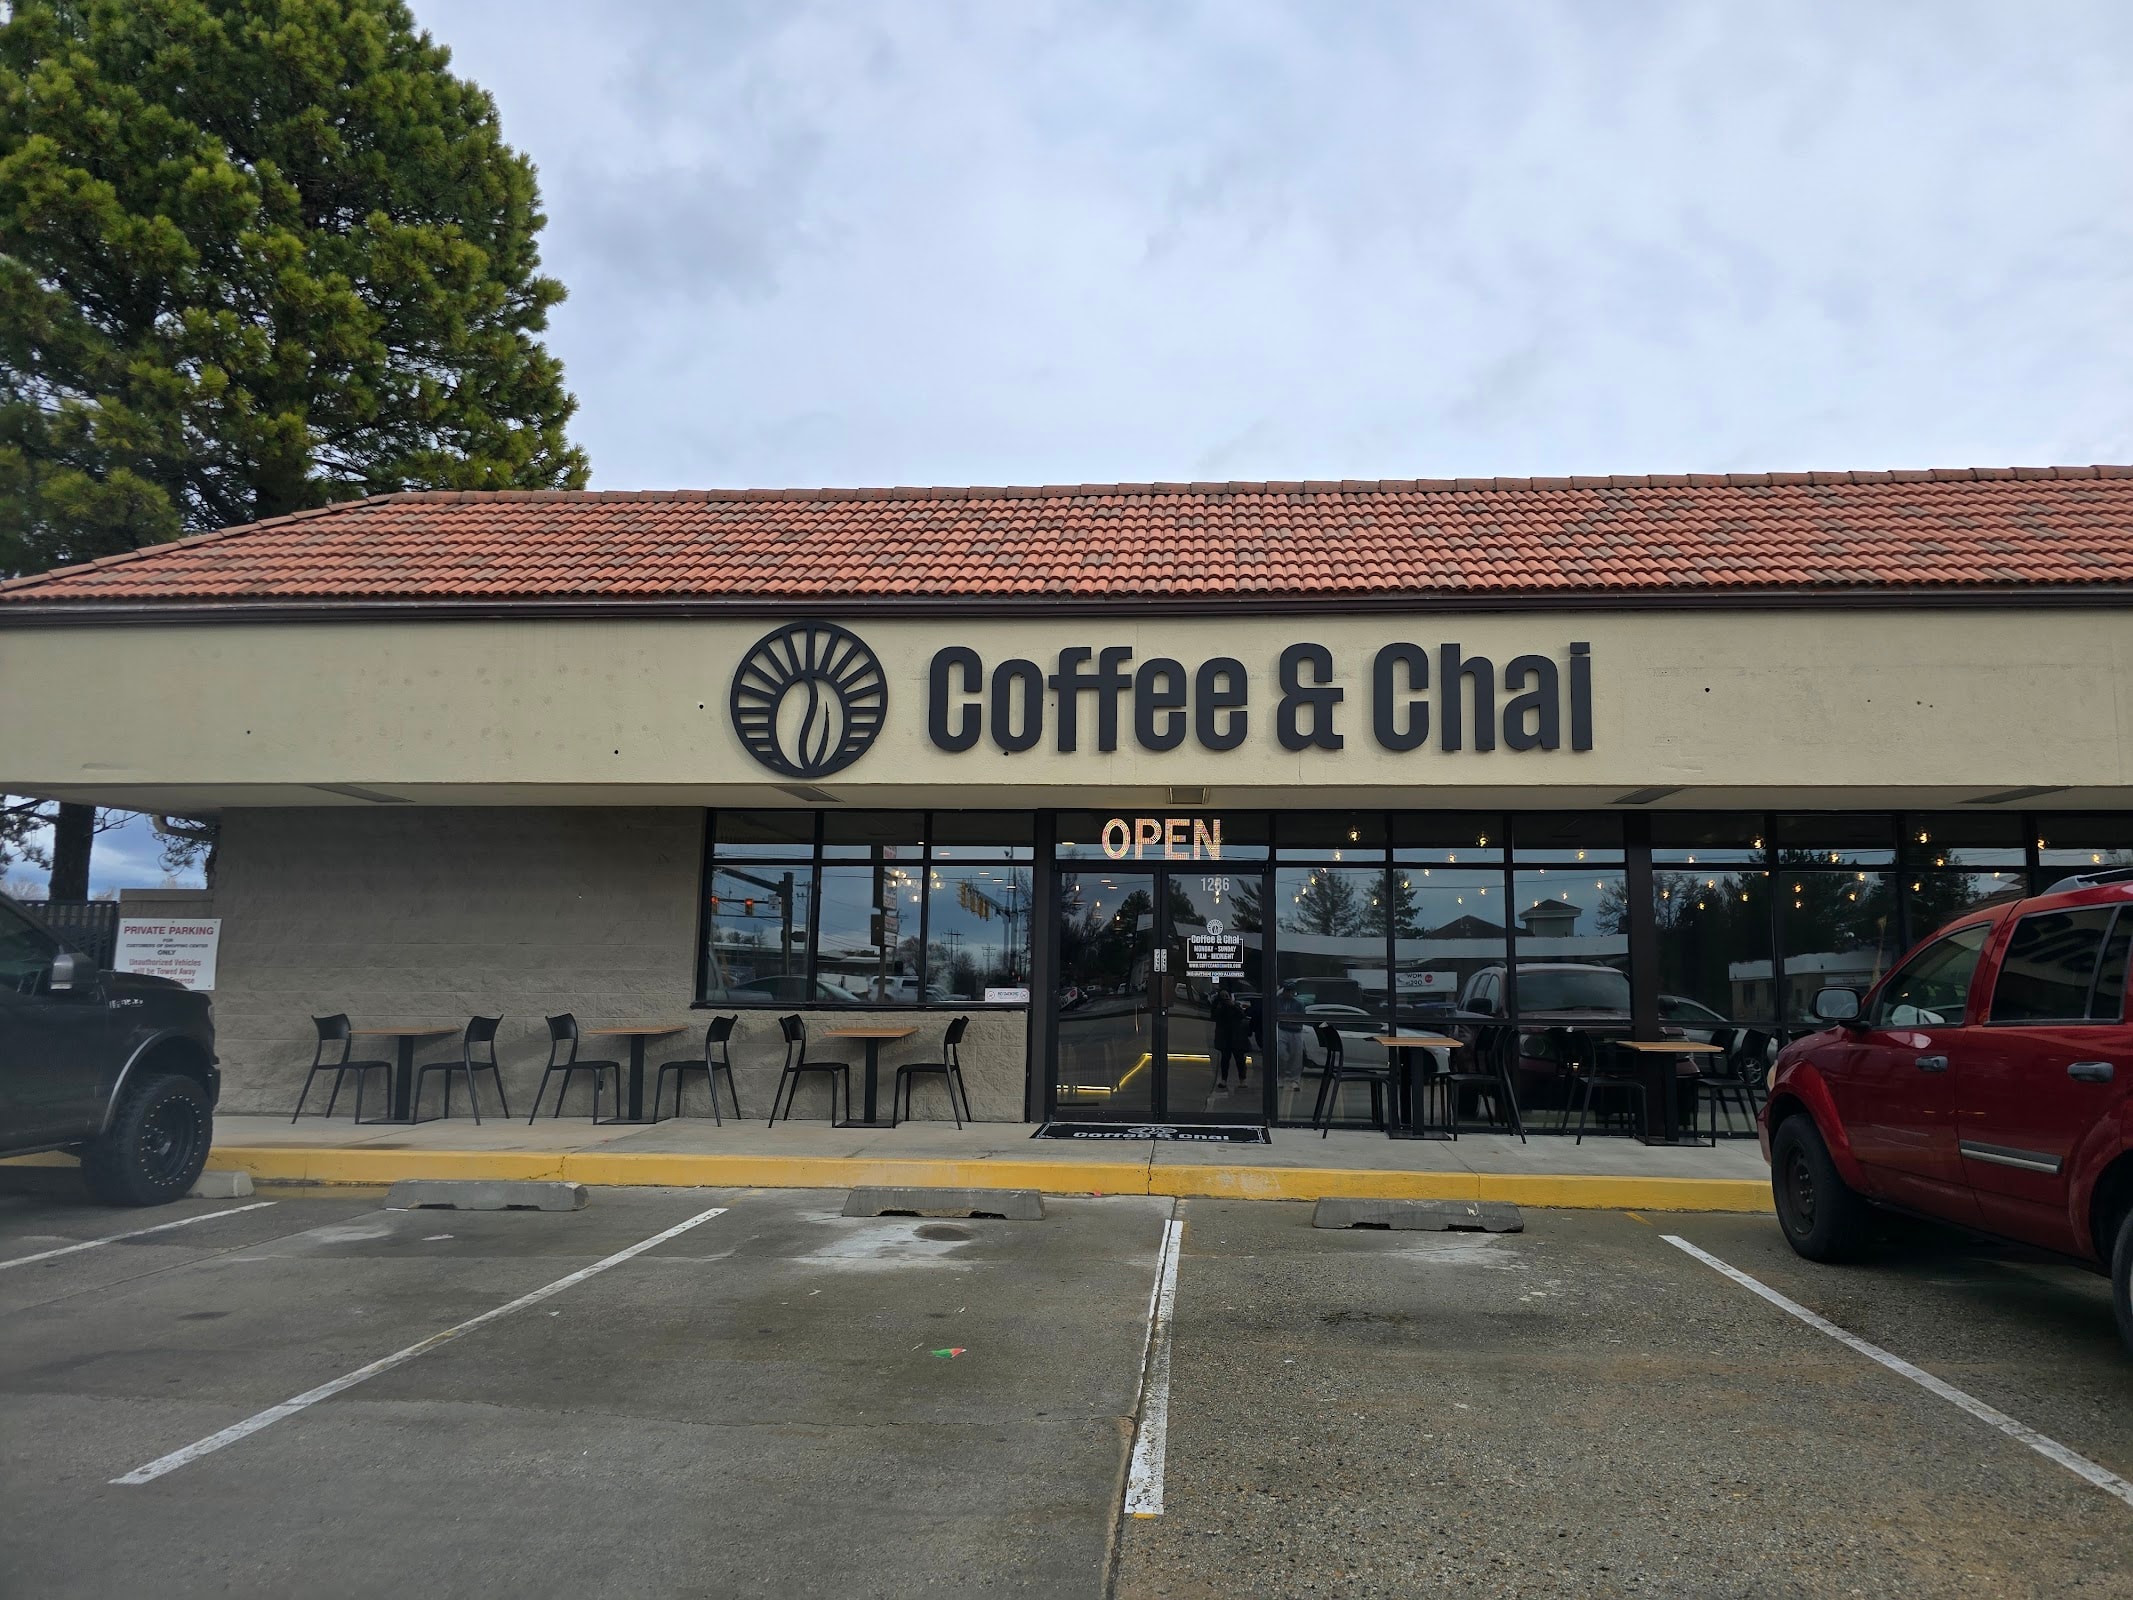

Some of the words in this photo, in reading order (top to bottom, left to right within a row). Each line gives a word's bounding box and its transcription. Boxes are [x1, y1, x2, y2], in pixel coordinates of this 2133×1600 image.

[928, 645, 1248, 752] Coffee
[1276, 642, 1344, 751] &
[1372, 641, 1593, 752] Chai
[1101, 816, 1221, 861] OPEN
[1200, 877, 1230, 891] 1286
[124, 926, 166, 935] PRIVATE
[168, 926, 214, 935] PARKING
[1191, 935, 1216, 944] Coffee
[1223, 935, 1240, 945] Chai
[129, 958, 173, 967] Unauthorized
[174, 959, 202, 967] Vehicles
[157, 967, 177, 975] Towed
[178, 968, 197, 976] Away
